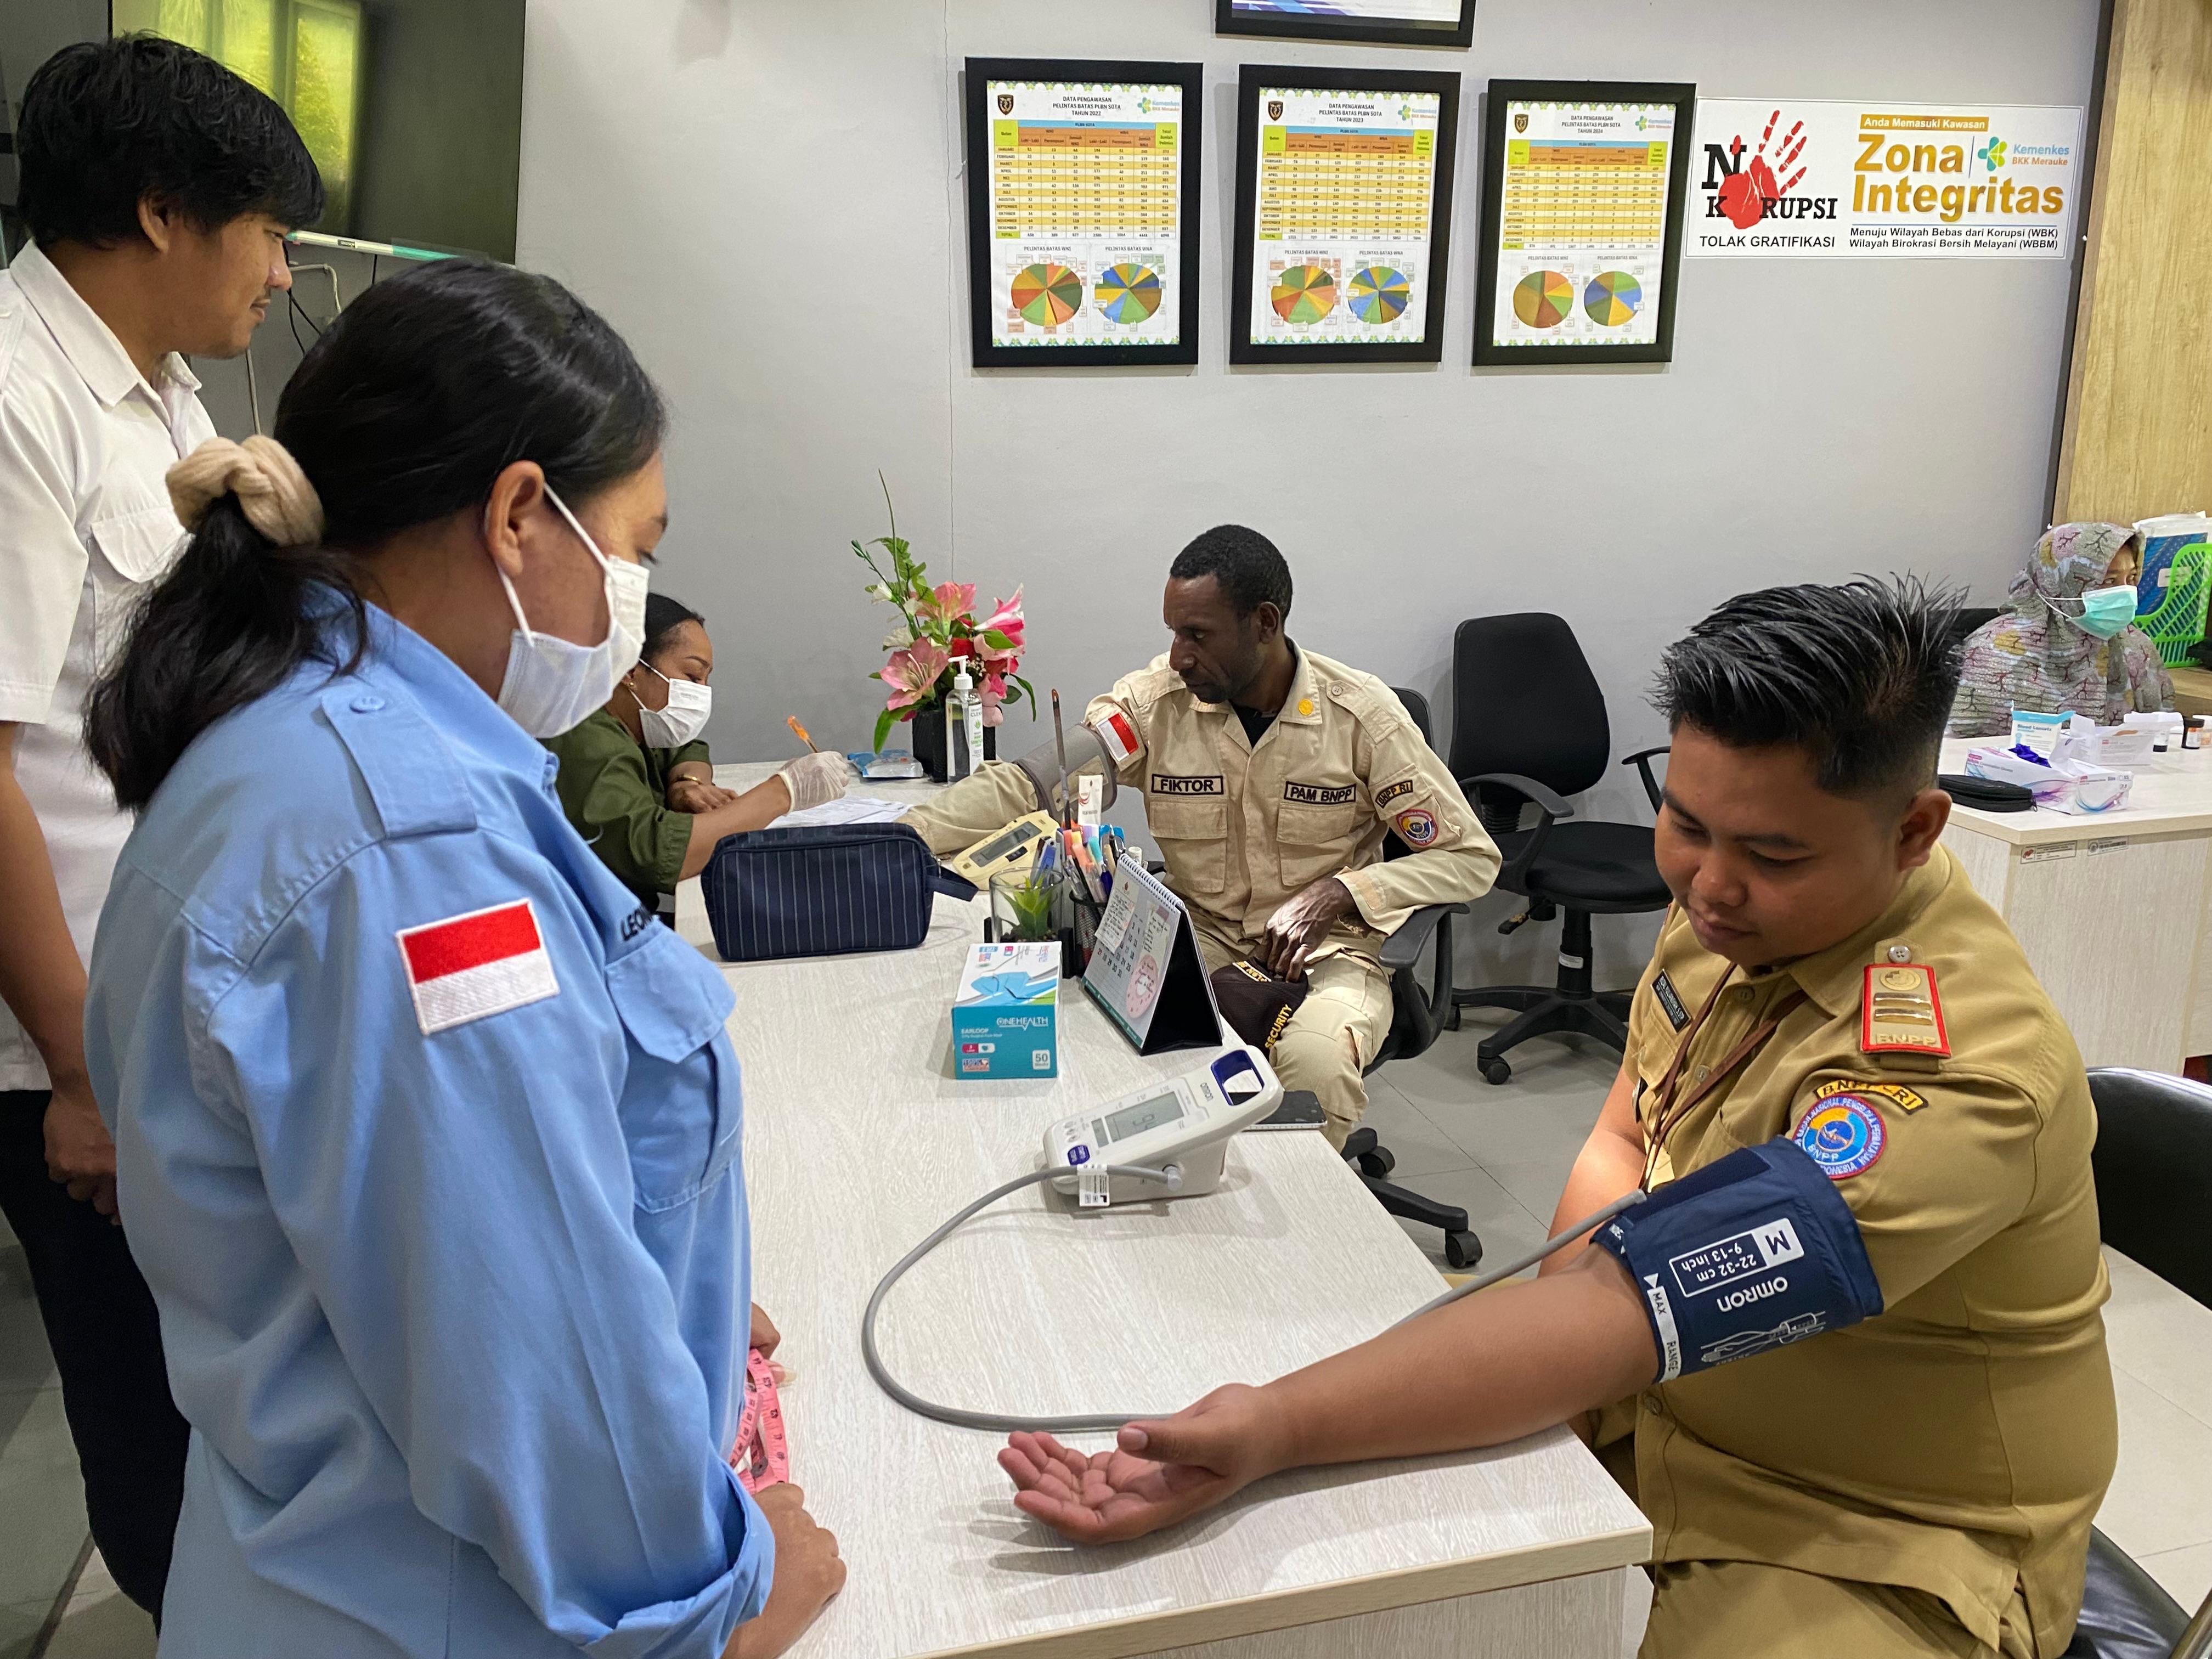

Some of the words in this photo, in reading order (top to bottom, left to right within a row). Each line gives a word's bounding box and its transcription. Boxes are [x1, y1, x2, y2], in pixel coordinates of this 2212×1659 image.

[1864, 118, 1889, 128] Anda
[1892, 119, 1940, 129] Memasuki
[1943, 120, 1985, 129] Kawasan
[1854, 134, 1964, 173] Zona
[2013, 144, 2069, 156] Kemenkes
[2032, 158, 2068, 166] Merauke
[1853, 175, 2063, 222] Integritas
[1706, 196, 1837, 219] KRUPSI
[1850, 228, 1887, 239] Menuju
[1891, 228, 1929, 238] Wilayah
[1933, 228, 1962, 237] Bebas
[1966, 228, 1984, 238] dari
[1988, 228, 2025, 239] Korupsi
[2028, 228, 2058, 238] (WBK)
[1700, 236, 1748, 247] TOLAK
[1751, 236, 1835, 248] GRATIFIKASI
[1850, 239, 1889, 250] Wilayah
[1893, 239, 1936, 249] Birokrasi
[1940, 239, 1970, 249] Bersih
[1974, 240, 2017, 250] Melayani
[2019, 240, 2058, 250] (WBBM)
[1160, 778, 1214, 792] FIKTOR
[1290, 786, 1318, 800] PAM
[1321, 788, 1352, 803] BNPP
[996, 1017, 1048, 1028] ONEHEALTH
[1265, 1004, 1292, 1048] SECURITY
[1877, 1034, 1936, 1045] BNPP
[1036, 1053, 1048, 1062] 50
[1808, 1144, 1839, 1161] BNPP
[1820, 1161, 1857, 1175] DONESIA
[1765, 1230, 1791, 1255] M
[1712, 1243, 1742, 1262] 9-13
[1681, 1255, 1708, 1272] inch
[1720, 1254, 1757, 1277] 22-32
[1696, 1271, 1716, 1282] cm
[1652, 1293, 1667, 1315] MAX
[1666, 1340, 1678, 1372] RANGE
